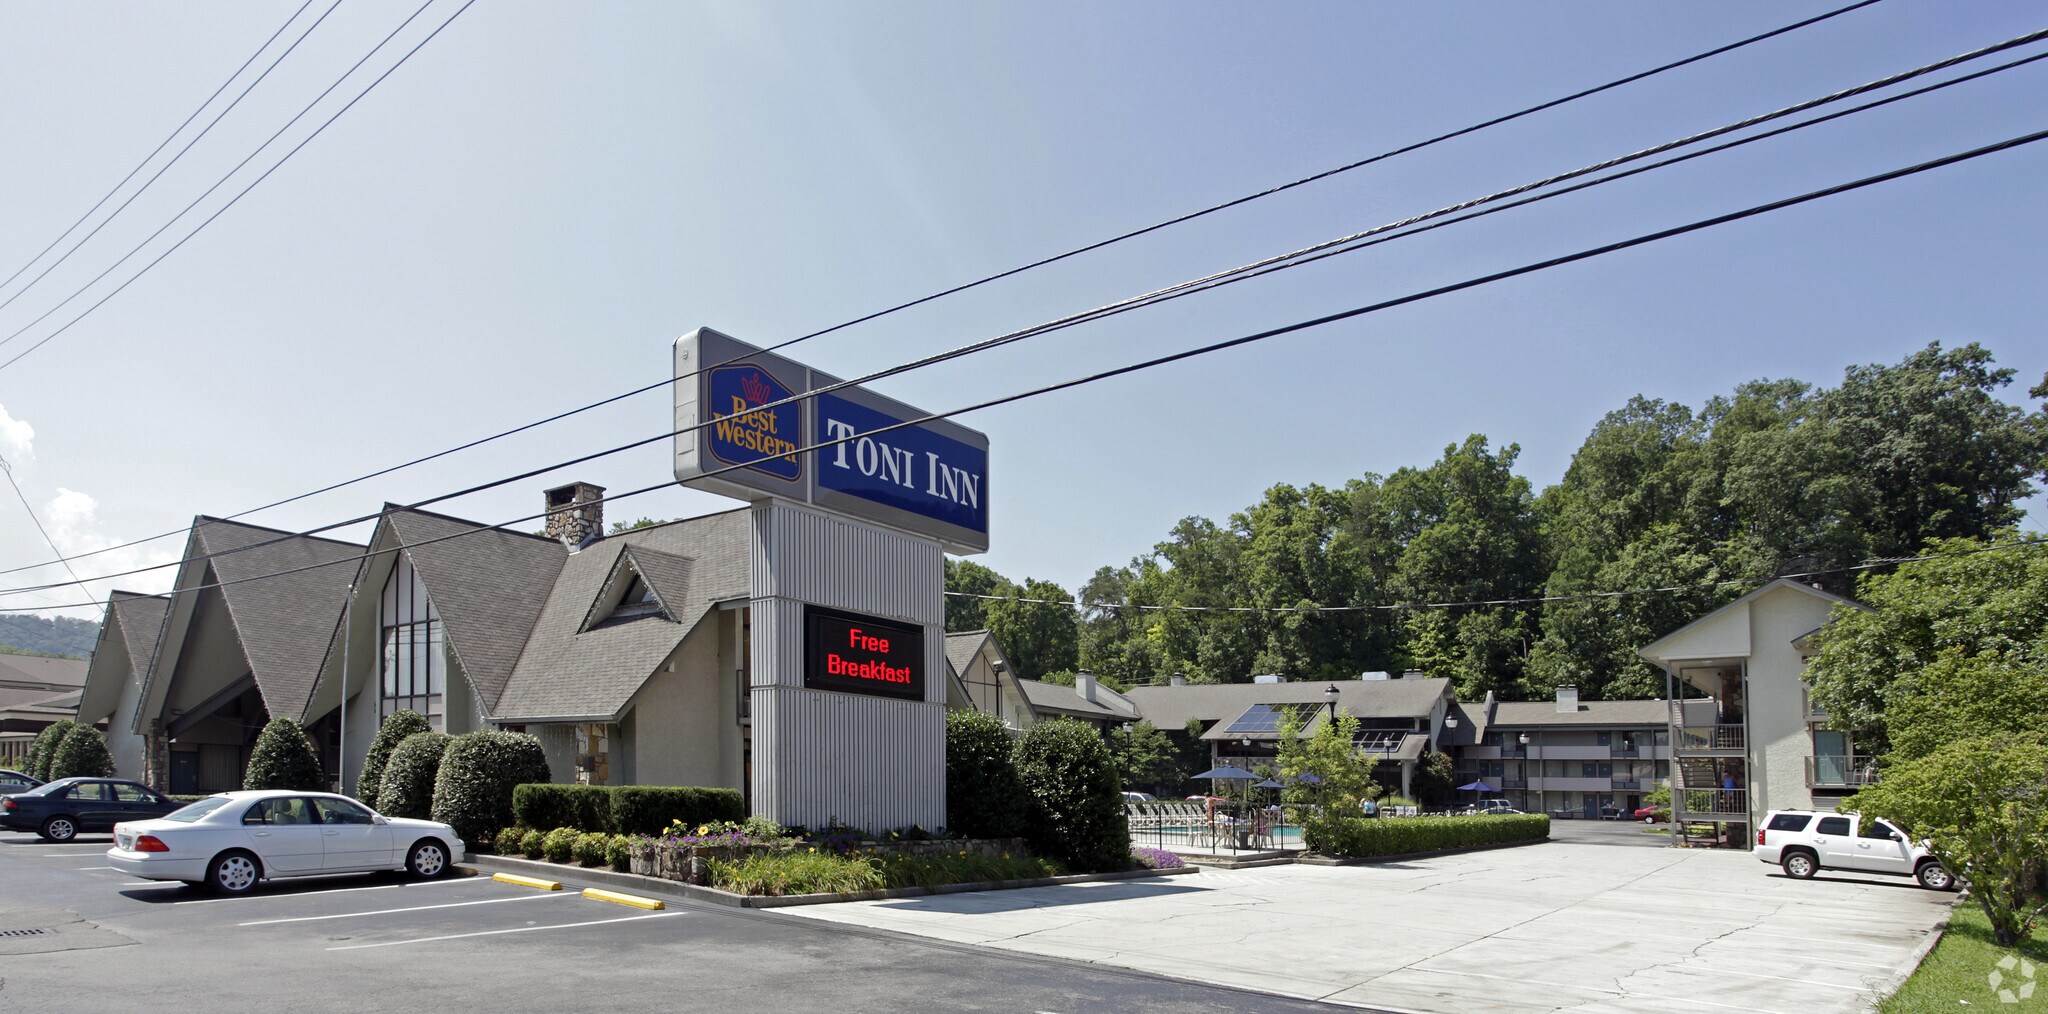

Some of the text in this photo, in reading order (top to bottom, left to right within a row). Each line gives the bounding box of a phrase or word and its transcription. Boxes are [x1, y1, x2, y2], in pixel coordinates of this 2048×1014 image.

[731, 395, 778, 434] Best
[713, 411, 798, 463] Western
[827, 418, 979, 509] TONI INN
[849, 628, 889, 654] Free
[827, 654, 910, 685] Breakfast
